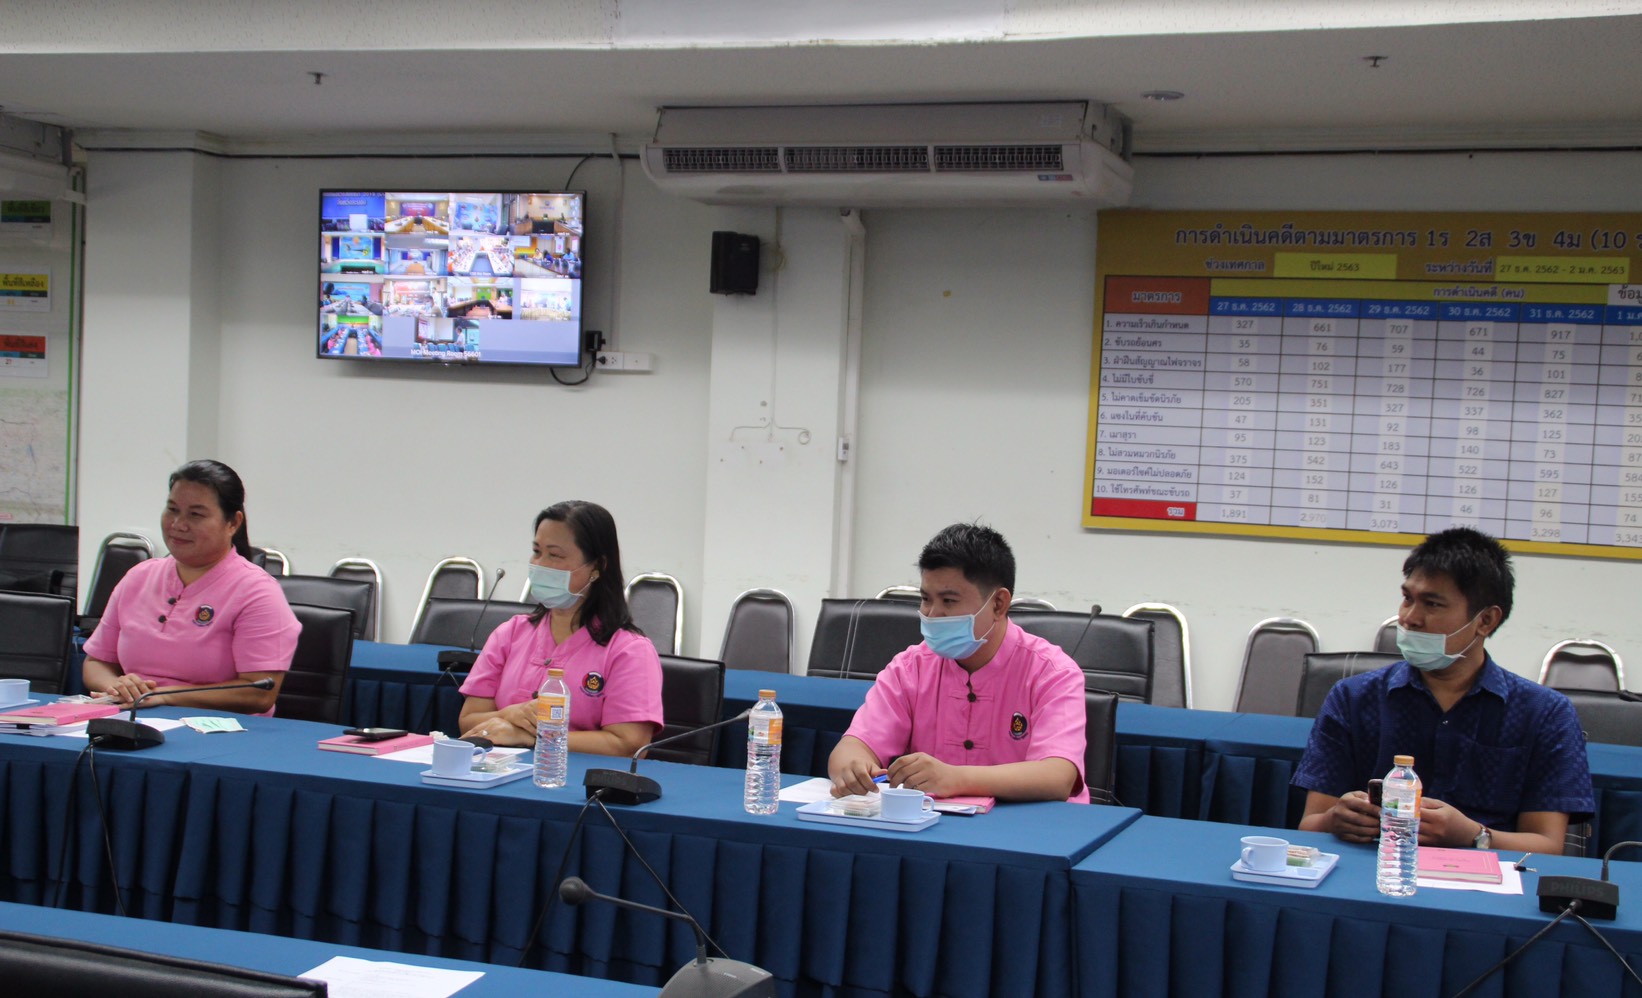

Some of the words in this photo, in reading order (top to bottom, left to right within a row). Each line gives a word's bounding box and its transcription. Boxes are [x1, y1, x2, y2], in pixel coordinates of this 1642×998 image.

[1175, 223, 1416, 246] การดำเนินคดีตามมาตรการ
[1465, 230, 1492, 247] 2ส
[1509, 231, 1536, 248] 3ข
[1554, 232, 1580, 248] 4ม
[1591, 229, 1627, 250] (10
[1205, 257, 1264, 271] ช่วงเทศกาล
[1337, 263, 1359, 271] 2563
[1500, 265, 1511, 273] 27
[1601, 266, 1625, 274] 2563
[1433, 286, 1497, 298] การดำเนินคดี
[1132, 292, 1181, 302] มาตรการ
[1217, 303, 1229, 311] 27
[1252, 303, 1275, 311] 2562
[1328, 305, 1352, 313] 2562
[1369, 305, 1381, 313] 29
[1405, 306, 1429, 315] 2562
[1486, 308, 1510, 317] 2562
[1529, 309, 1541, 317] 31
[1568, 310, 1594, 318] 2562
[1107, 320, 1112, 328] 1.
[1236, 320, 1254, 328] 327
[1314, 323, 1331, 332] 661
[1390, 325, 1408, 334] 707
[1469, 327, 1488, 336] 671
[1551, 330, 1571, 339] 917
[1239, 340, 1250, 348] 35
[1316, 342, 1327, 351] 76
[1392, 345, 1404, 353] 59
[1472, 347, 1484, 356] 44
[1553, 350, 1565, 359] 75
[1238, 358, 1249, 366] 58
[1312, 362, 1330, 370] 102
[1388, 364, 1406, 373] 177
[1471, 367, 1483, 375] 36
[1547, 370, 1565, 379] 101
[1235, 378, 1252, 386] 570
[1311, 380, 1328, 388] 751
[1386, 384, 1404, 393] 728
[1467, 387, 1485, 396] 726
[1544, 390, 1564, 398] 827
[1233, 397, 1251, 405] 205
[1310, 399, 1327, 407] 351
[1385, 403, 1404, 412] 327
[1465, 406, 1483, 416] 337
[1544, 410, 1562, 419] 362
[1235, 416, 1246, 424] 47
[1310, 418, 1326, 427] 131
[1387, 423, 1399, 431] 92
[1466, 427, 1479, 435] 98
[1109, 431, 1136, 441] เมาสุรา
[1234, 433, 1246, 442] 95
[1543, 430, 1561, 439] 125
[1308, 437, 1326, 446] 123
[1383, 441, 1400, 450] 183
[1109, 447, 1176, 459] ไม่สวมหมวกนิรภัย
[1461, 445, 1479, 454] 140
[1544, 449, 1556, 458] 73
[1230, 455, 1247, 464] 375
[1307, 456, 1325, 464] 542
[1380, 461, 1398, 470] 643
[1459, 465, 1477, 474] 522
[1229, 472, 1245, 480] 124
[1540, 469, 1559, 478] 595
[1307, 475, 1323, 484] 152
[1097, 485, 1108, 493] 10.
[1380, 480, 1397, 489] 126
[1230, 490, 1241, 498] 37
[1459, 485, 1477, 494] 126
[1539, 488, 1557, 497] 127
[1308, 494, 1319, 503] 81
[1380, 500, 1391, 509] 31
[1460, 504, 1473, 513] 46
[1168, 507, 1184, 516] รวม
[1222, 508, 1246, 518] 1,891
[1540, 509, 1552, 518] 96
[1301, 513, 1326, 523] 2,970
[1624, 514, 1637, 522] 74
[1371, 519, 1398, 529] 3,073
[1532, 528, 1560, 537] 3,298
[1550, 880, 1604, 897] PHILIPS
